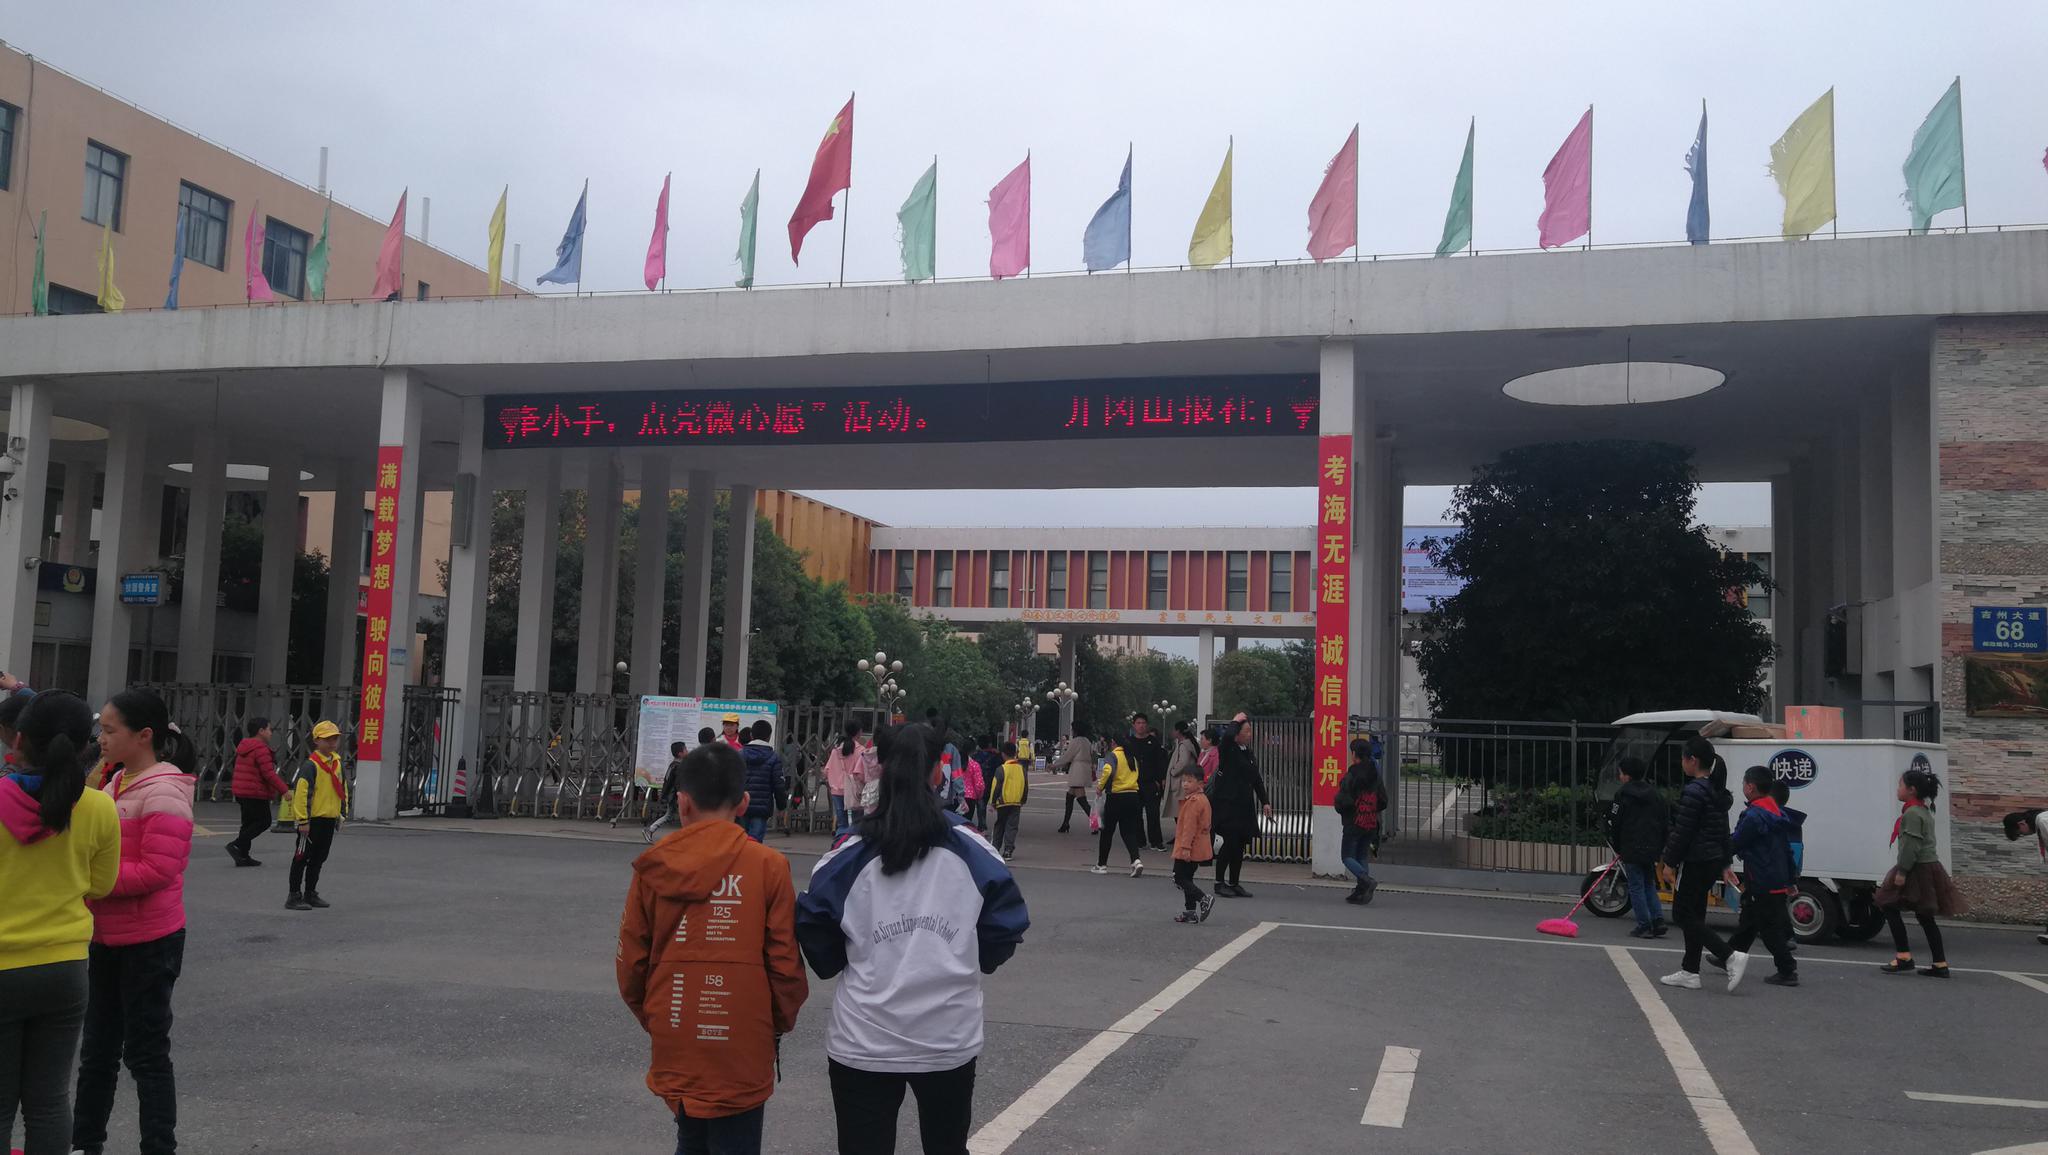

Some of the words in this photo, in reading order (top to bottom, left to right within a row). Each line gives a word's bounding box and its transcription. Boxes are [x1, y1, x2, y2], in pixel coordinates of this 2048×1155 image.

[373, 463, 398, 590] 满载梦想
[1322, 454, 1347, 605] 考海无涯
[1981, 610, 2040, 621] 吉州大道
[1996, 620, 2025, 641] 68
[361, 616, 388, 745] 驶向彼岸
[1318, 634, 1344, 788] 诚信作舟
[1772, 757, 1814, 782] 快递
[713, 906, 731, 919] 125
[705, 974, 724, 987] 158
